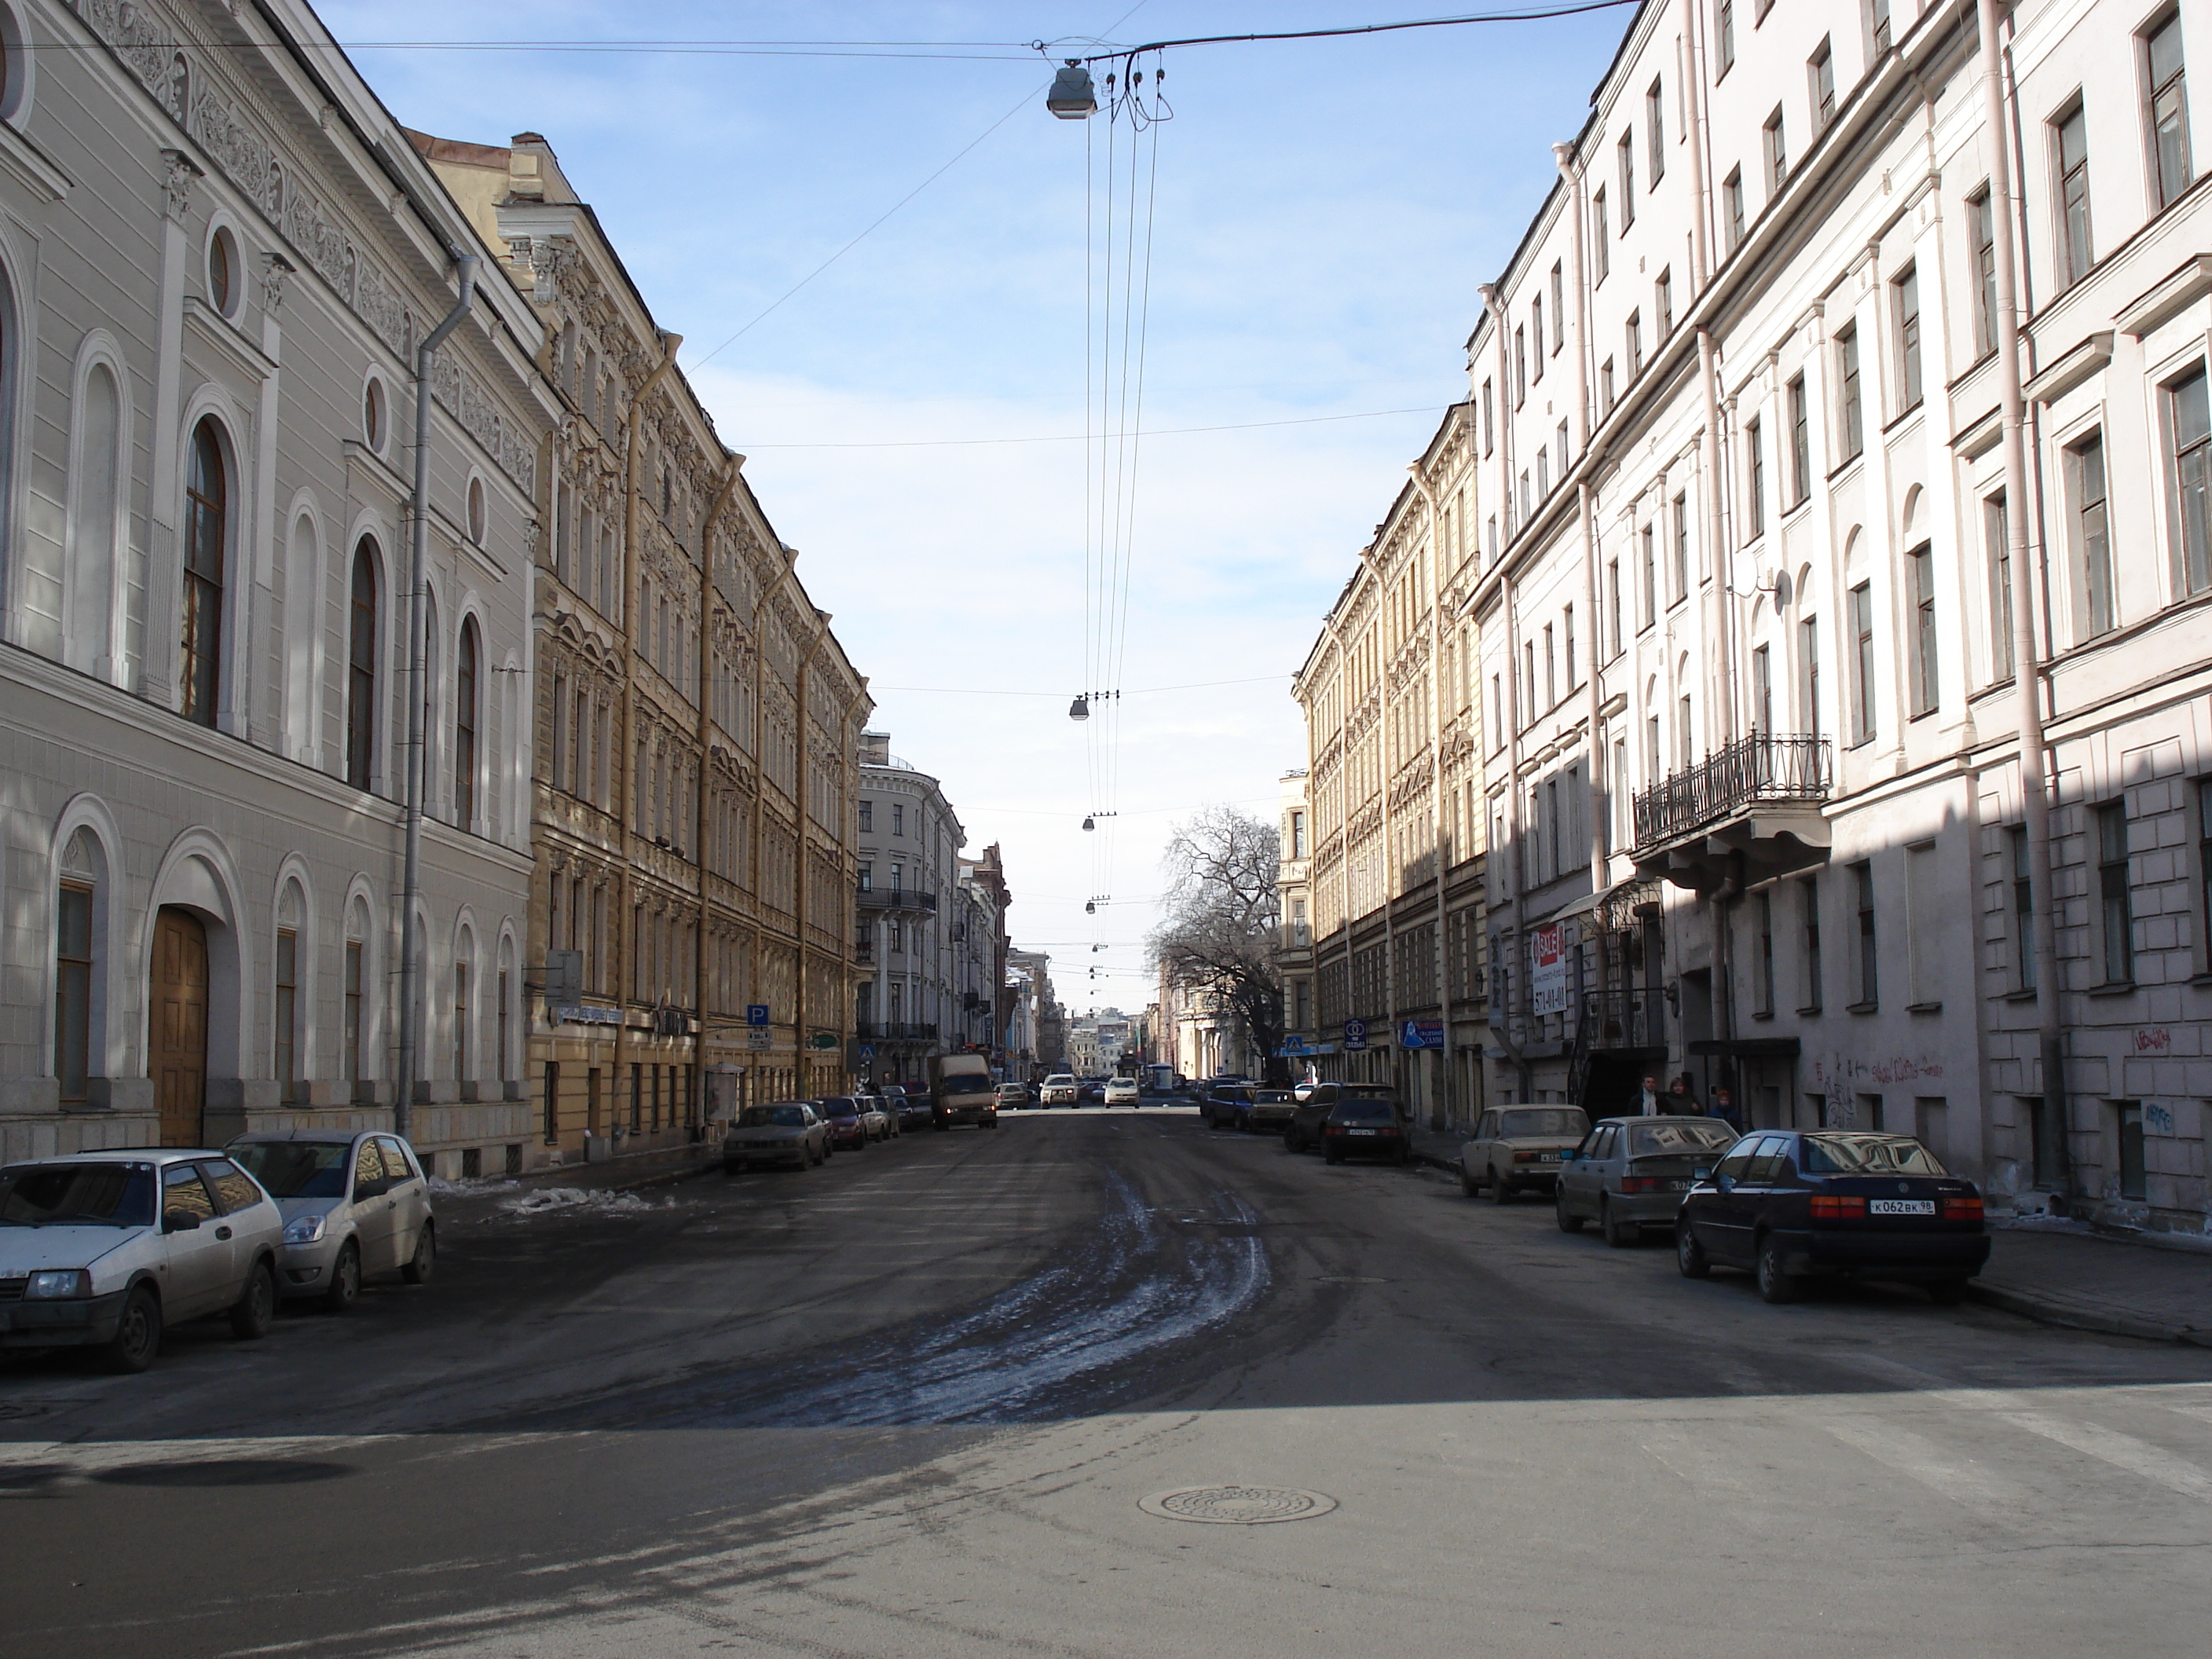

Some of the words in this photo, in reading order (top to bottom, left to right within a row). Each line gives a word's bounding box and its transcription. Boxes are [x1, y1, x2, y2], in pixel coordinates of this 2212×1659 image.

[1540, 932, 1557, 958] SALE
[1535, 985, 1566, 1012] 571-01-01
[752, 1007, 764, 1023] P
